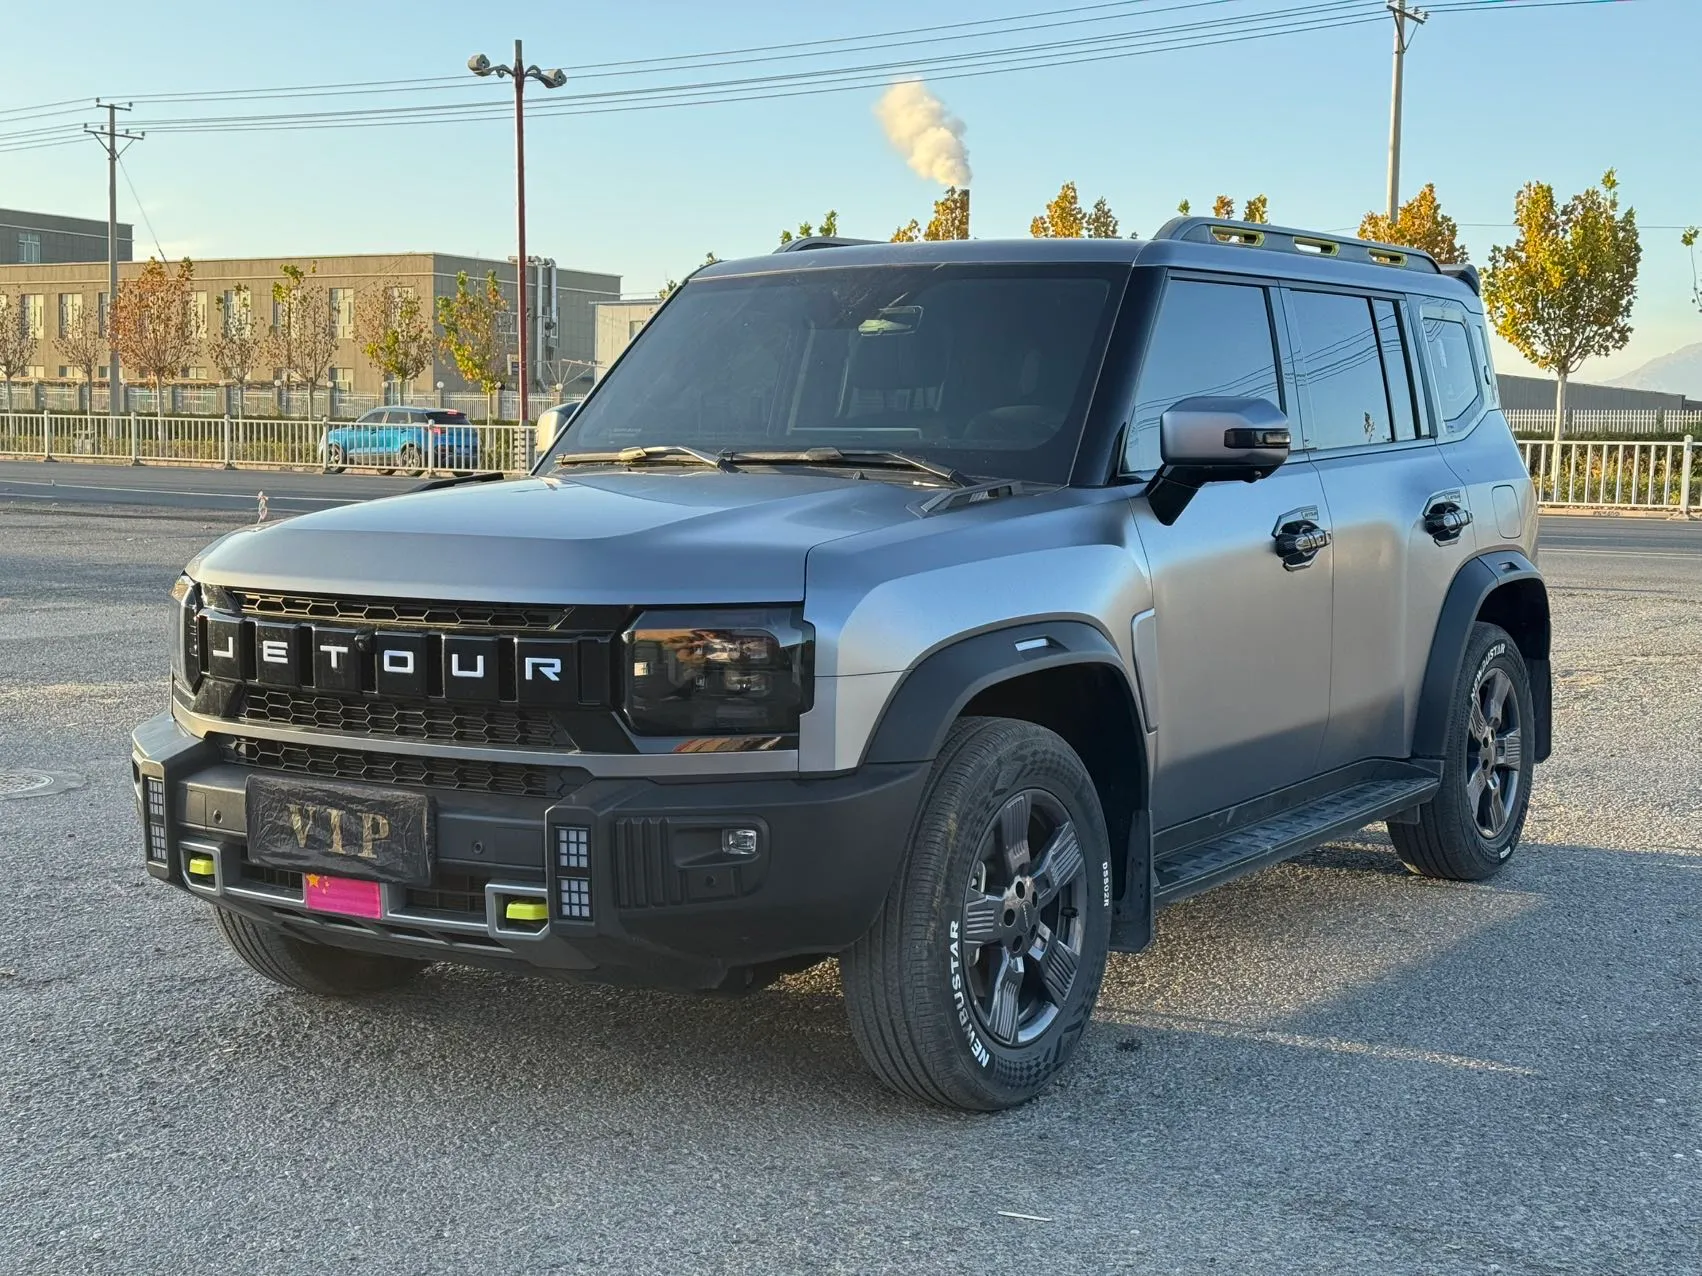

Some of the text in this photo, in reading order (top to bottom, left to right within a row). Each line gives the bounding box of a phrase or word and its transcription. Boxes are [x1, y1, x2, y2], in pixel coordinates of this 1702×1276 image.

[213, 636, 562, 682] JETOUR
[286, 803, 391, 859] VIP
[950, 920, 990, 1068] NEWBUSTAR
